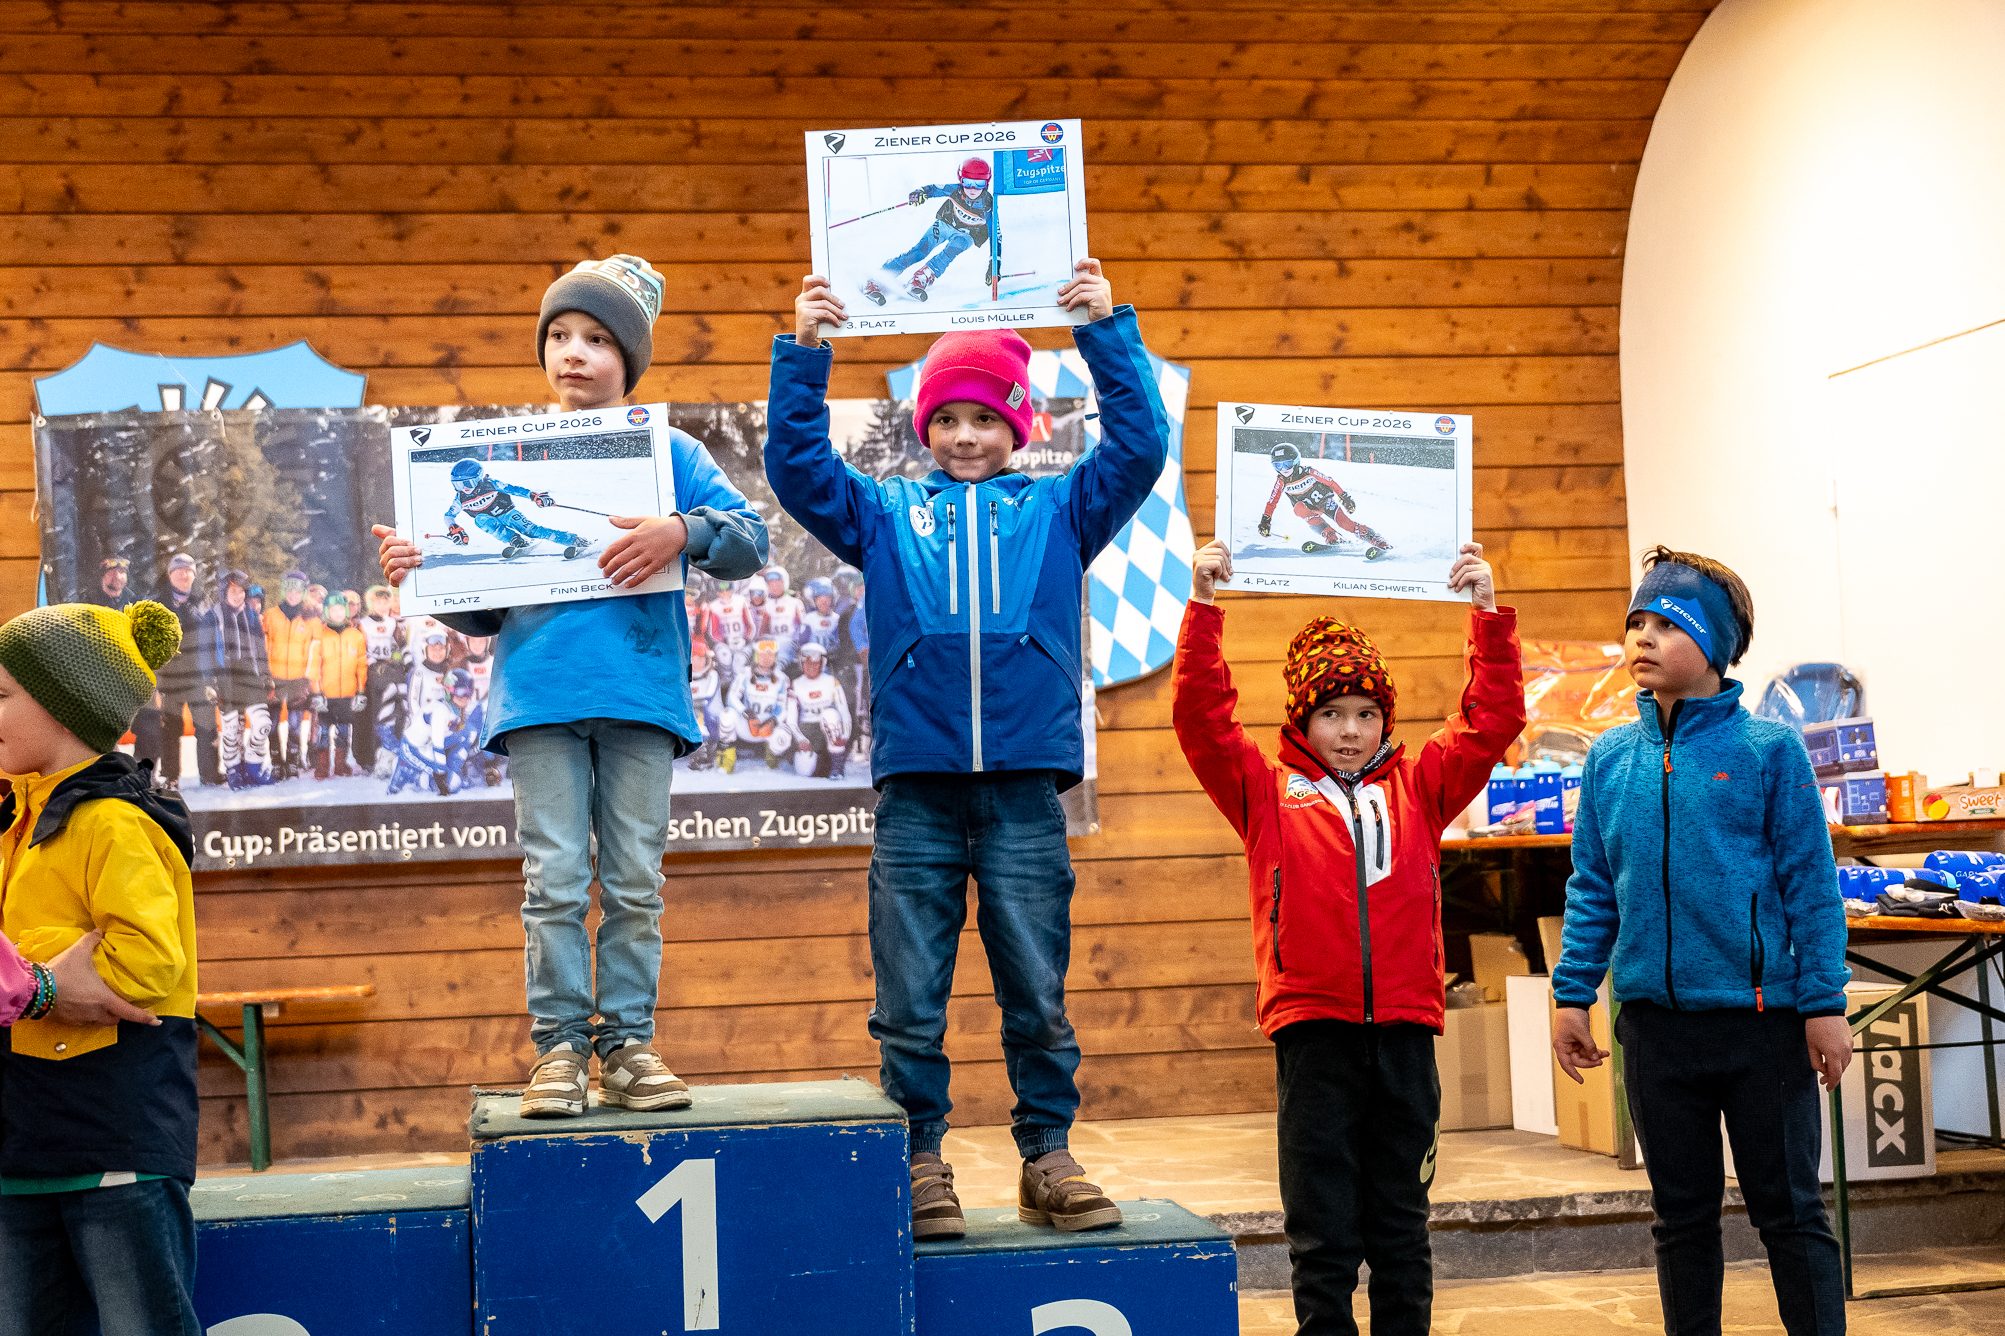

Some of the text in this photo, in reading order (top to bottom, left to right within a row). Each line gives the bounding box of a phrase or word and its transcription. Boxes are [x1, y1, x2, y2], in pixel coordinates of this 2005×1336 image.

[973, 131, 1016, 142] 2026
[1016, 165, 1065, 178] Zugspitze
[846, 321, 857, 330] 3.
[559, 416, 603, 428] 2026
[1372, 418, 1412, 429] 2026
[1010, 448, 1073, 469] gspitze
[1244, 577, 1254, 586] 4.
[433, 599, 441, 607] 1.
[1671, 604, 1707, 634] ziener
[1960, 793, 2002, 810] Sweet
[204, 830, 272, 863] Cup:
[279, 821, 444, 855] Präsentiert
[452, 825, 506, 848] von
[666, 810, 751, 841] schen
[758, 806, 876, 844] Zugspit
[1869, 1012, 1911, 1157] Tacx
[635, 1158, 720, 1331] 1
